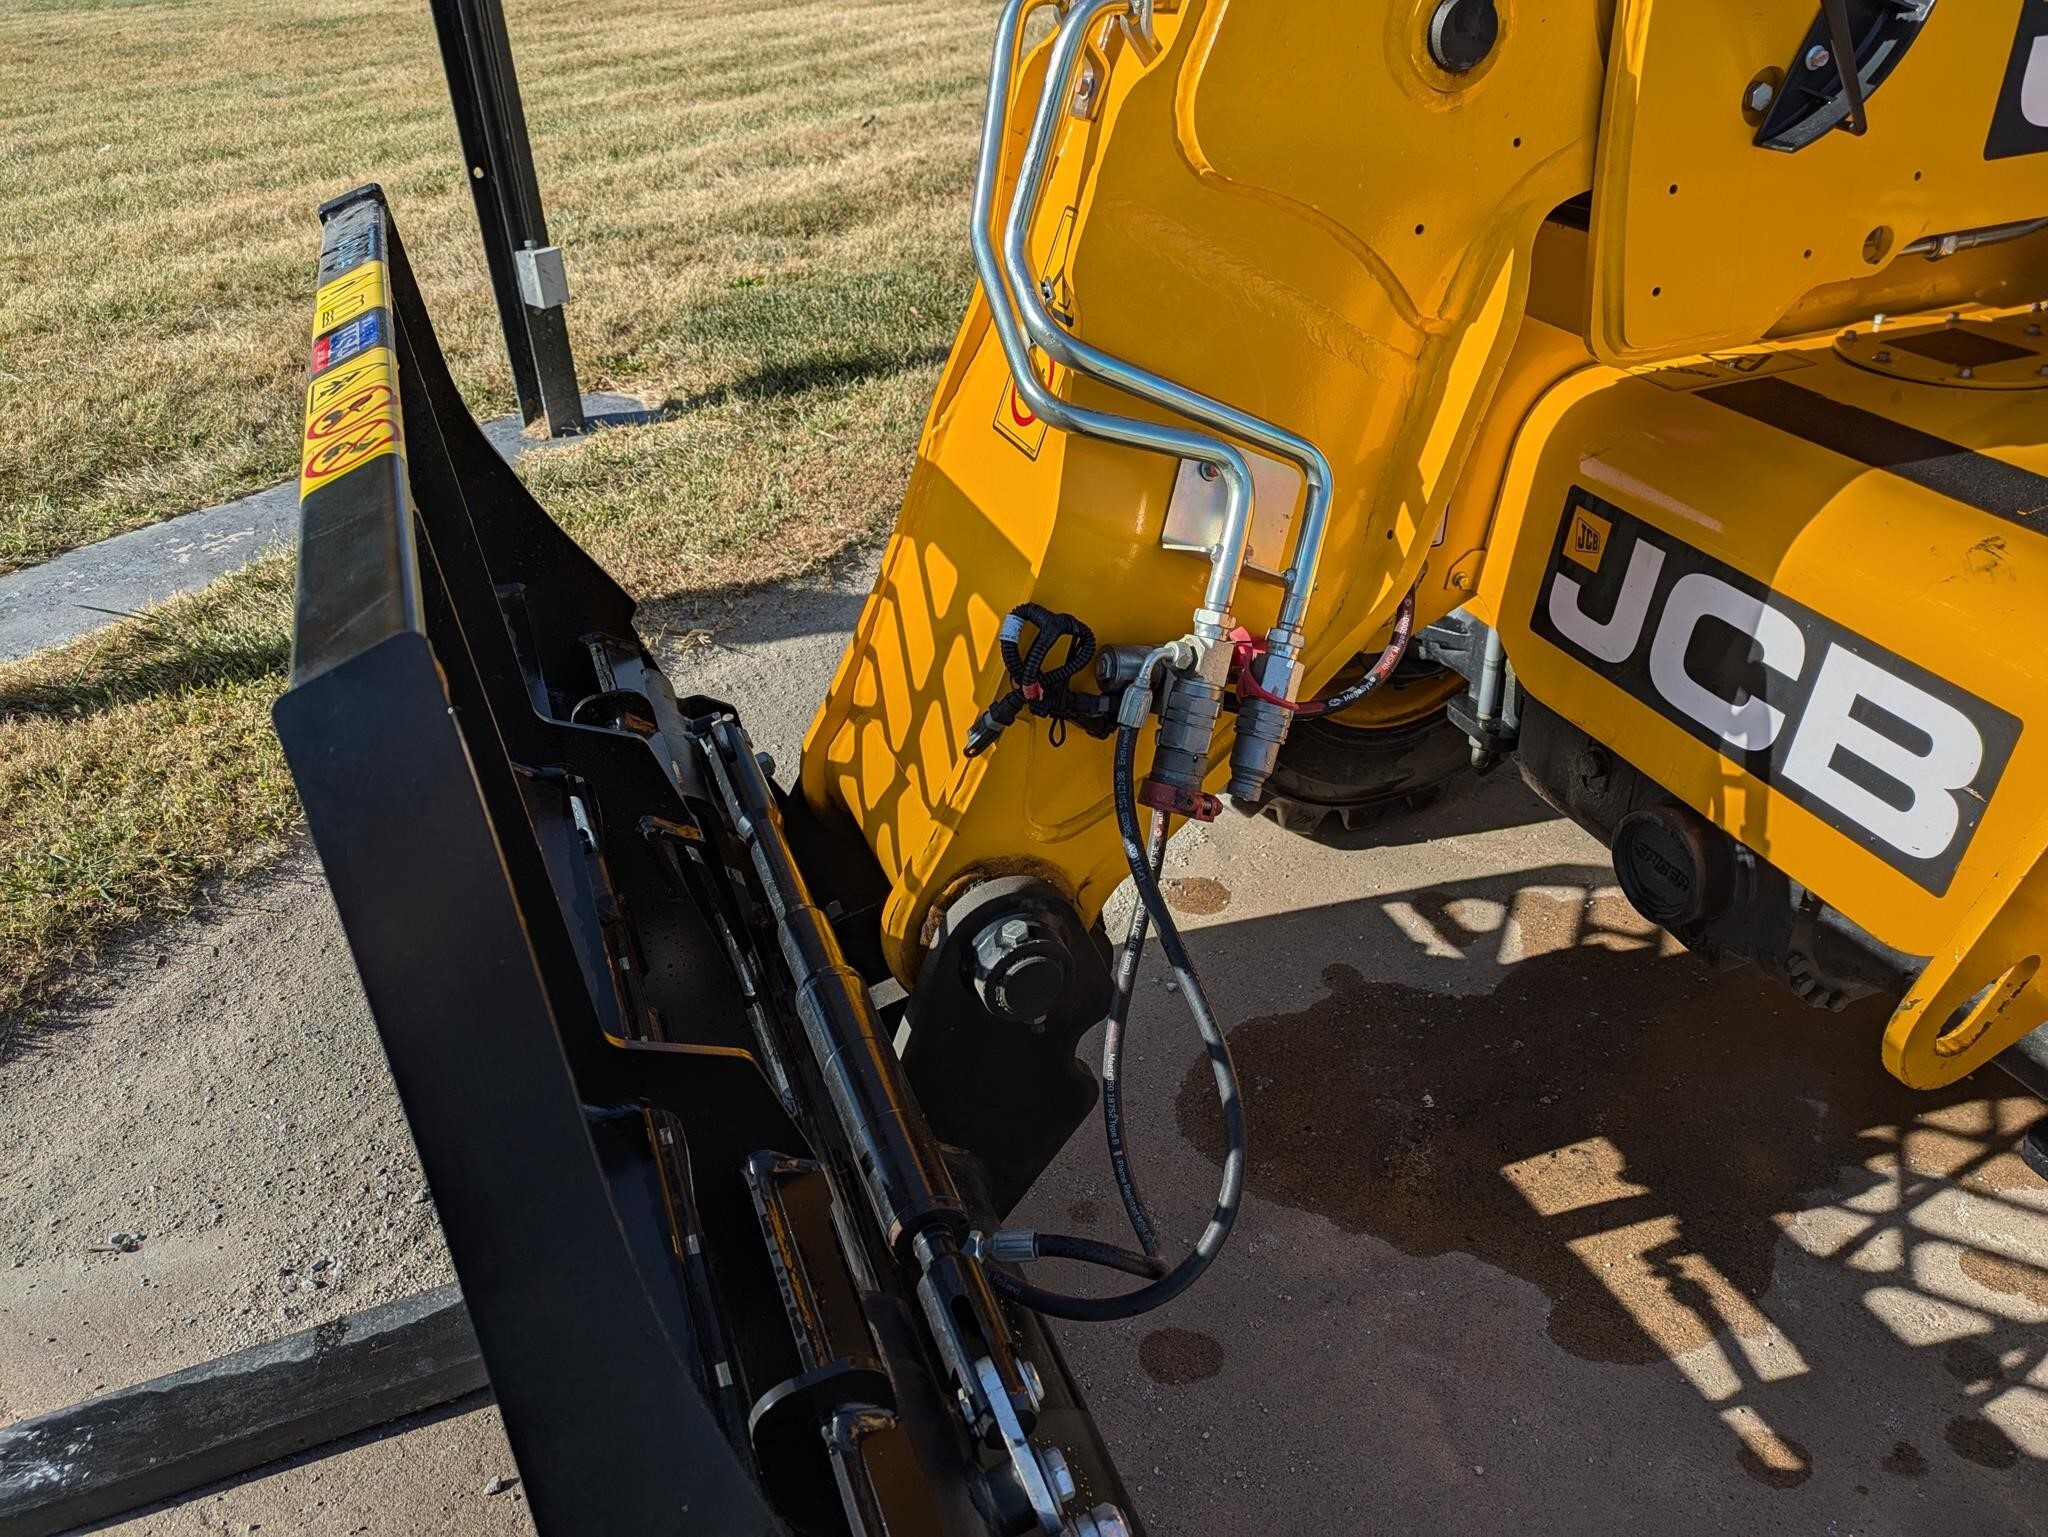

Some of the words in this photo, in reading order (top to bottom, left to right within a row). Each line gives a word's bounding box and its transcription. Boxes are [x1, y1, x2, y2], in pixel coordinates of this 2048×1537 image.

[1577, 522, 1599, 551] JCB
[1549, 538, 1983, 859] JCB
[1636, 842, 1690, 892] SPIDER
[1109, 1118, 1119, 1138] Type
